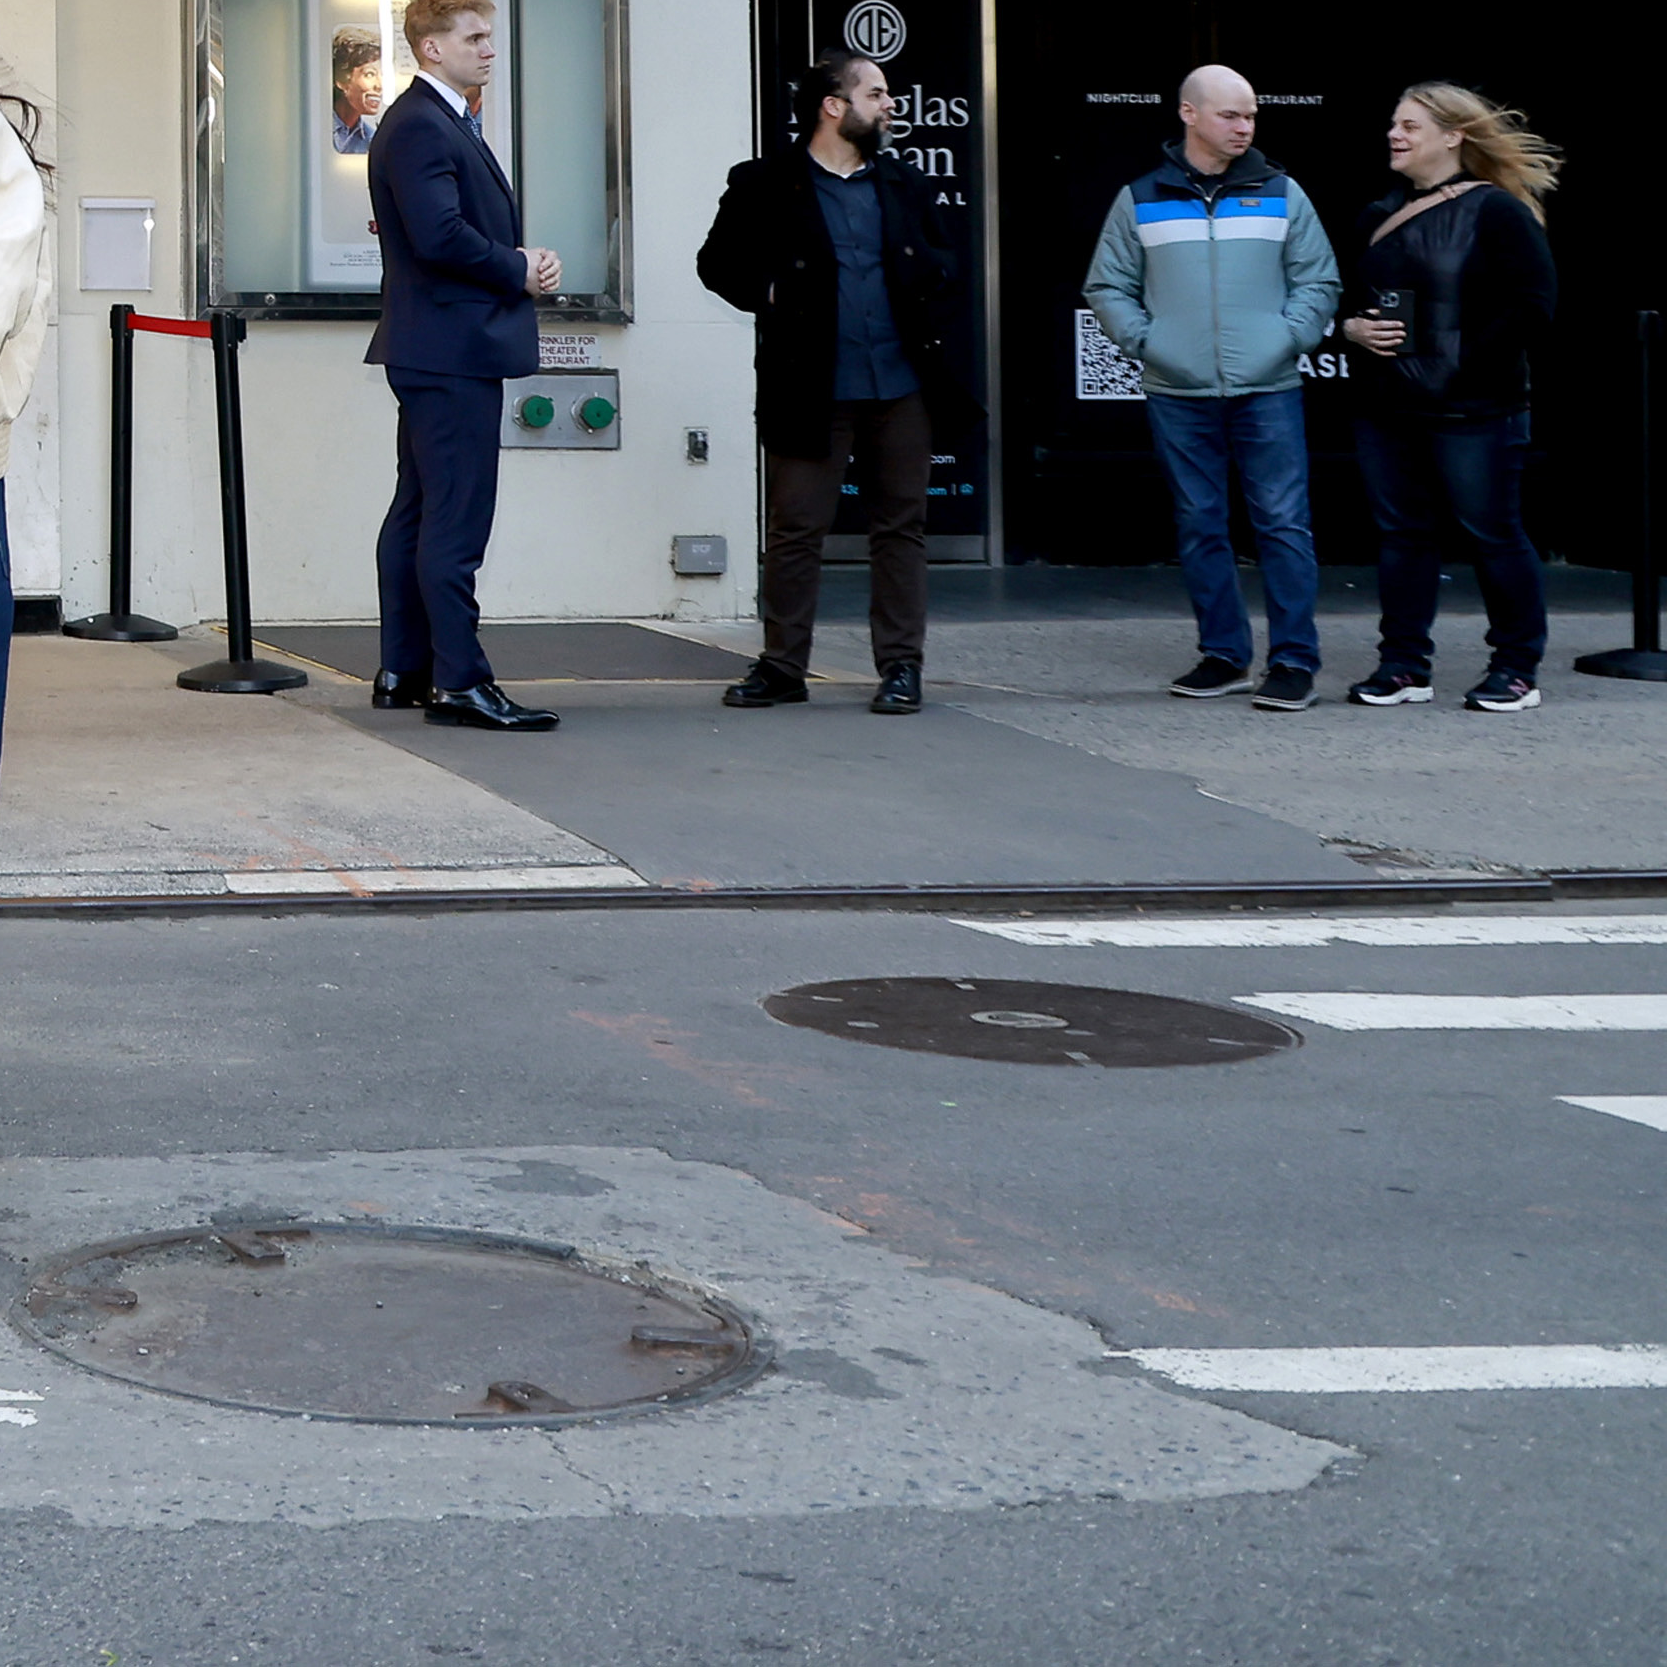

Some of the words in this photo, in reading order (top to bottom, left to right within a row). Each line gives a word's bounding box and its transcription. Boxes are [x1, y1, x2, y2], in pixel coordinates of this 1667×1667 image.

[1086, 93, 1161, 104] NIGHTCLUB
[578, 336, 595, 345] FOR
[540, 346, 577, 355] THEATER
